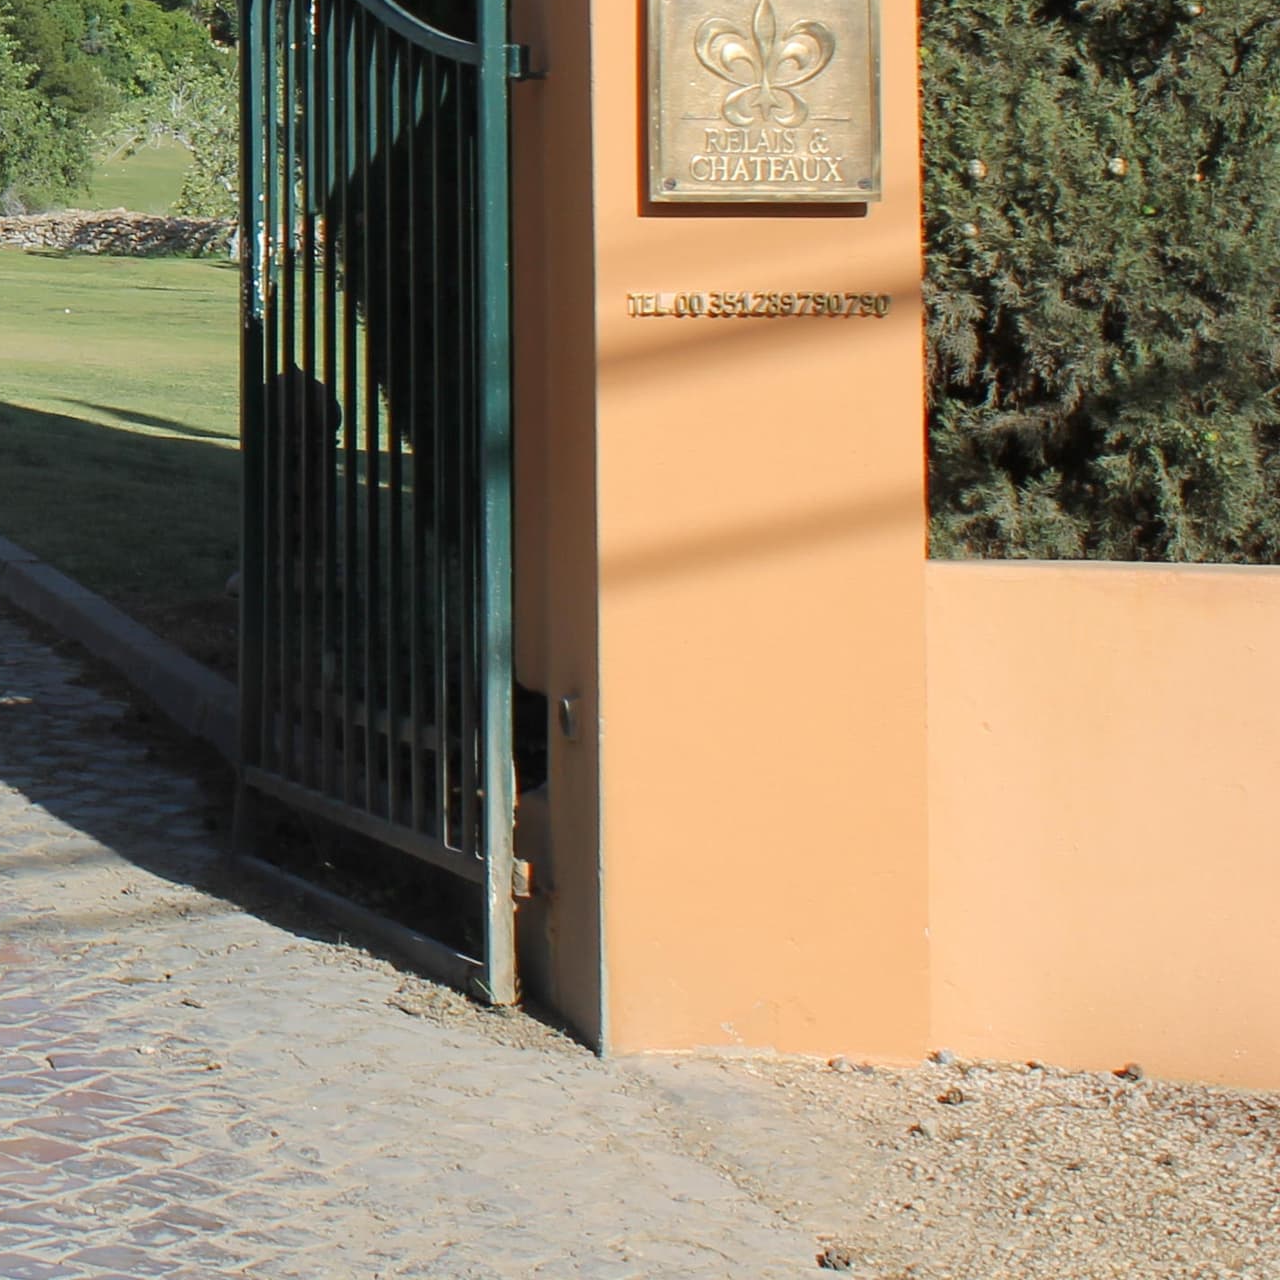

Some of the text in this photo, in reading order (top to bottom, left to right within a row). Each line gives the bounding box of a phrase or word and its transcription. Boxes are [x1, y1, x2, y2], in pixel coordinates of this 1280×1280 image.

[704, 127, 829, 154] RELAIS &
[690, 156, 843, 182] CHATEAUX
